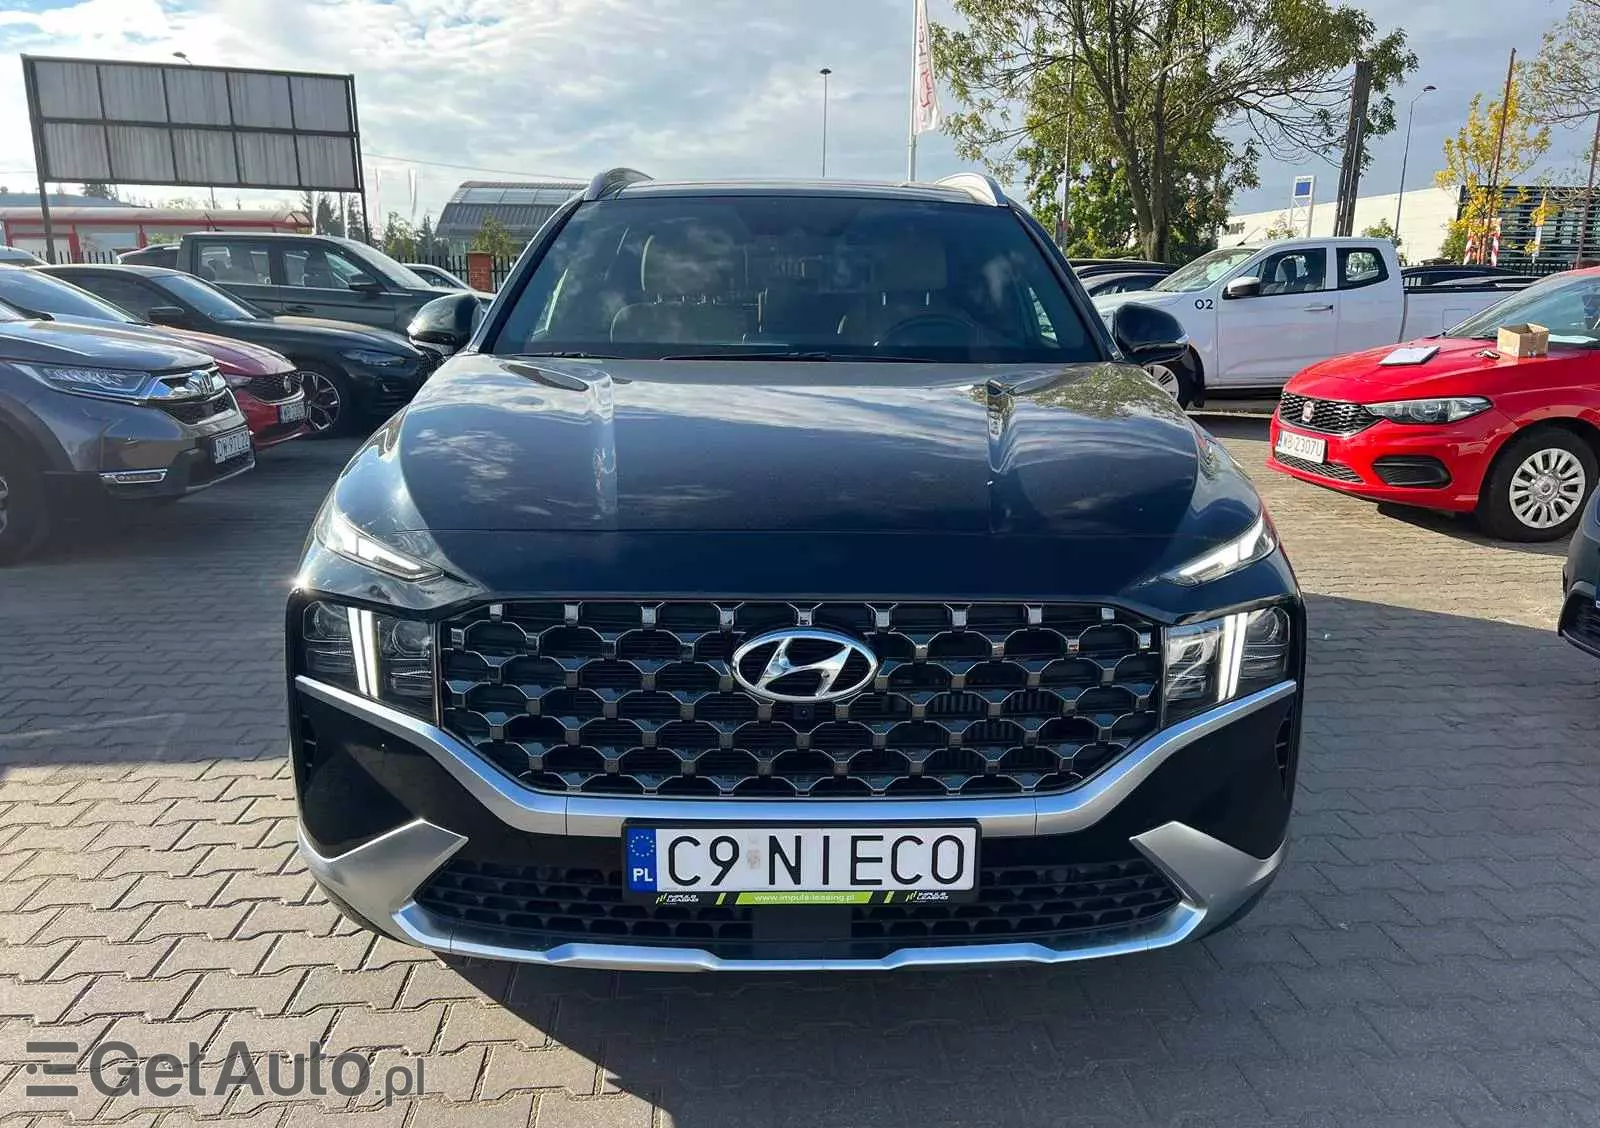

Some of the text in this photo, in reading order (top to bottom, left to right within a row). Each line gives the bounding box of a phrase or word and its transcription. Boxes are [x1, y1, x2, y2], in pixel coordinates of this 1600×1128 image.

[632, 867, 653, 882] PL
[668, 835, 965, 886] C9 NIECO
